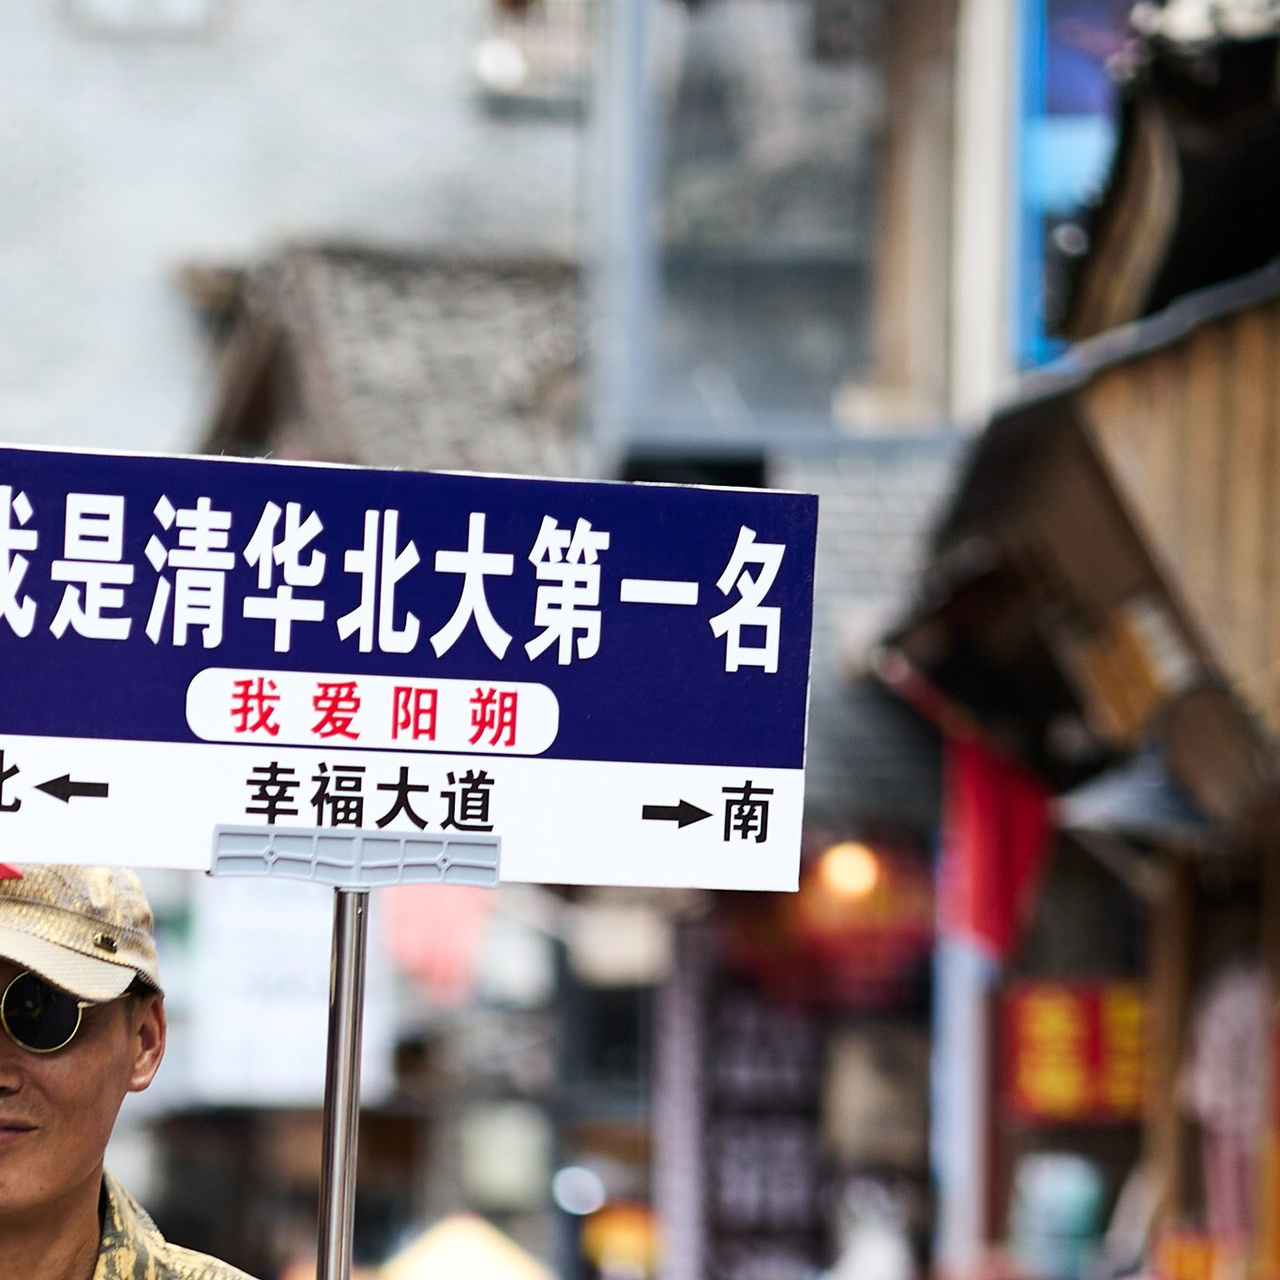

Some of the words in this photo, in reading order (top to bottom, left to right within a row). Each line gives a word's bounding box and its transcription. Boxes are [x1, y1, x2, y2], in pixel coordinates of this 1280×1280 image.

[230, 677, 518, 747] 我爱阳朔
[245, 761, 495, 832] 幸福大道
[721, 779, 775, 844] 南
